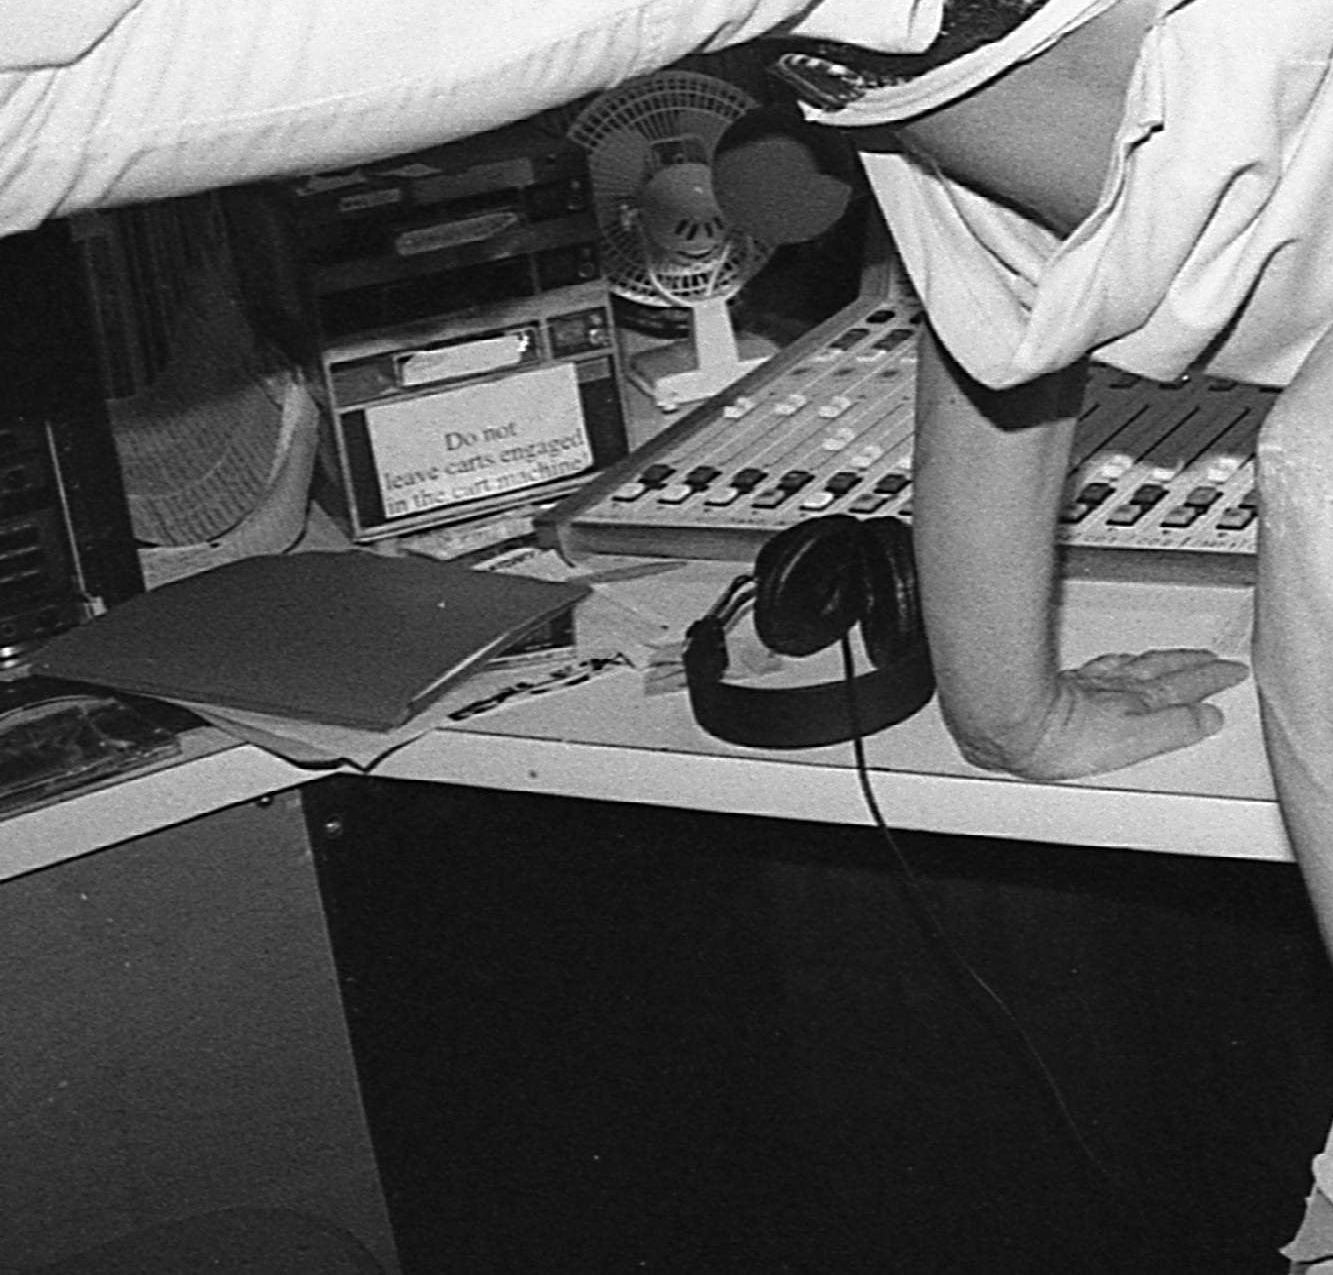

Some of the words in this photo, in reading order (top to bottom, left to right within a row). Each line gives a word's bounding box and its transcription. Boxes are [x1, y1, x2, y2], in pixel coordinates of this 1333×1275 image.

[444, 431, 478, 452] Do
[483, 422, 518, 443] not
[384, 467, 440, 491] leave
[446, 455, 497, 476] carts
[500, 427, 585, 463] engaged
[386, 497, 409, 516] in
[412, 489, 446, 509] the
